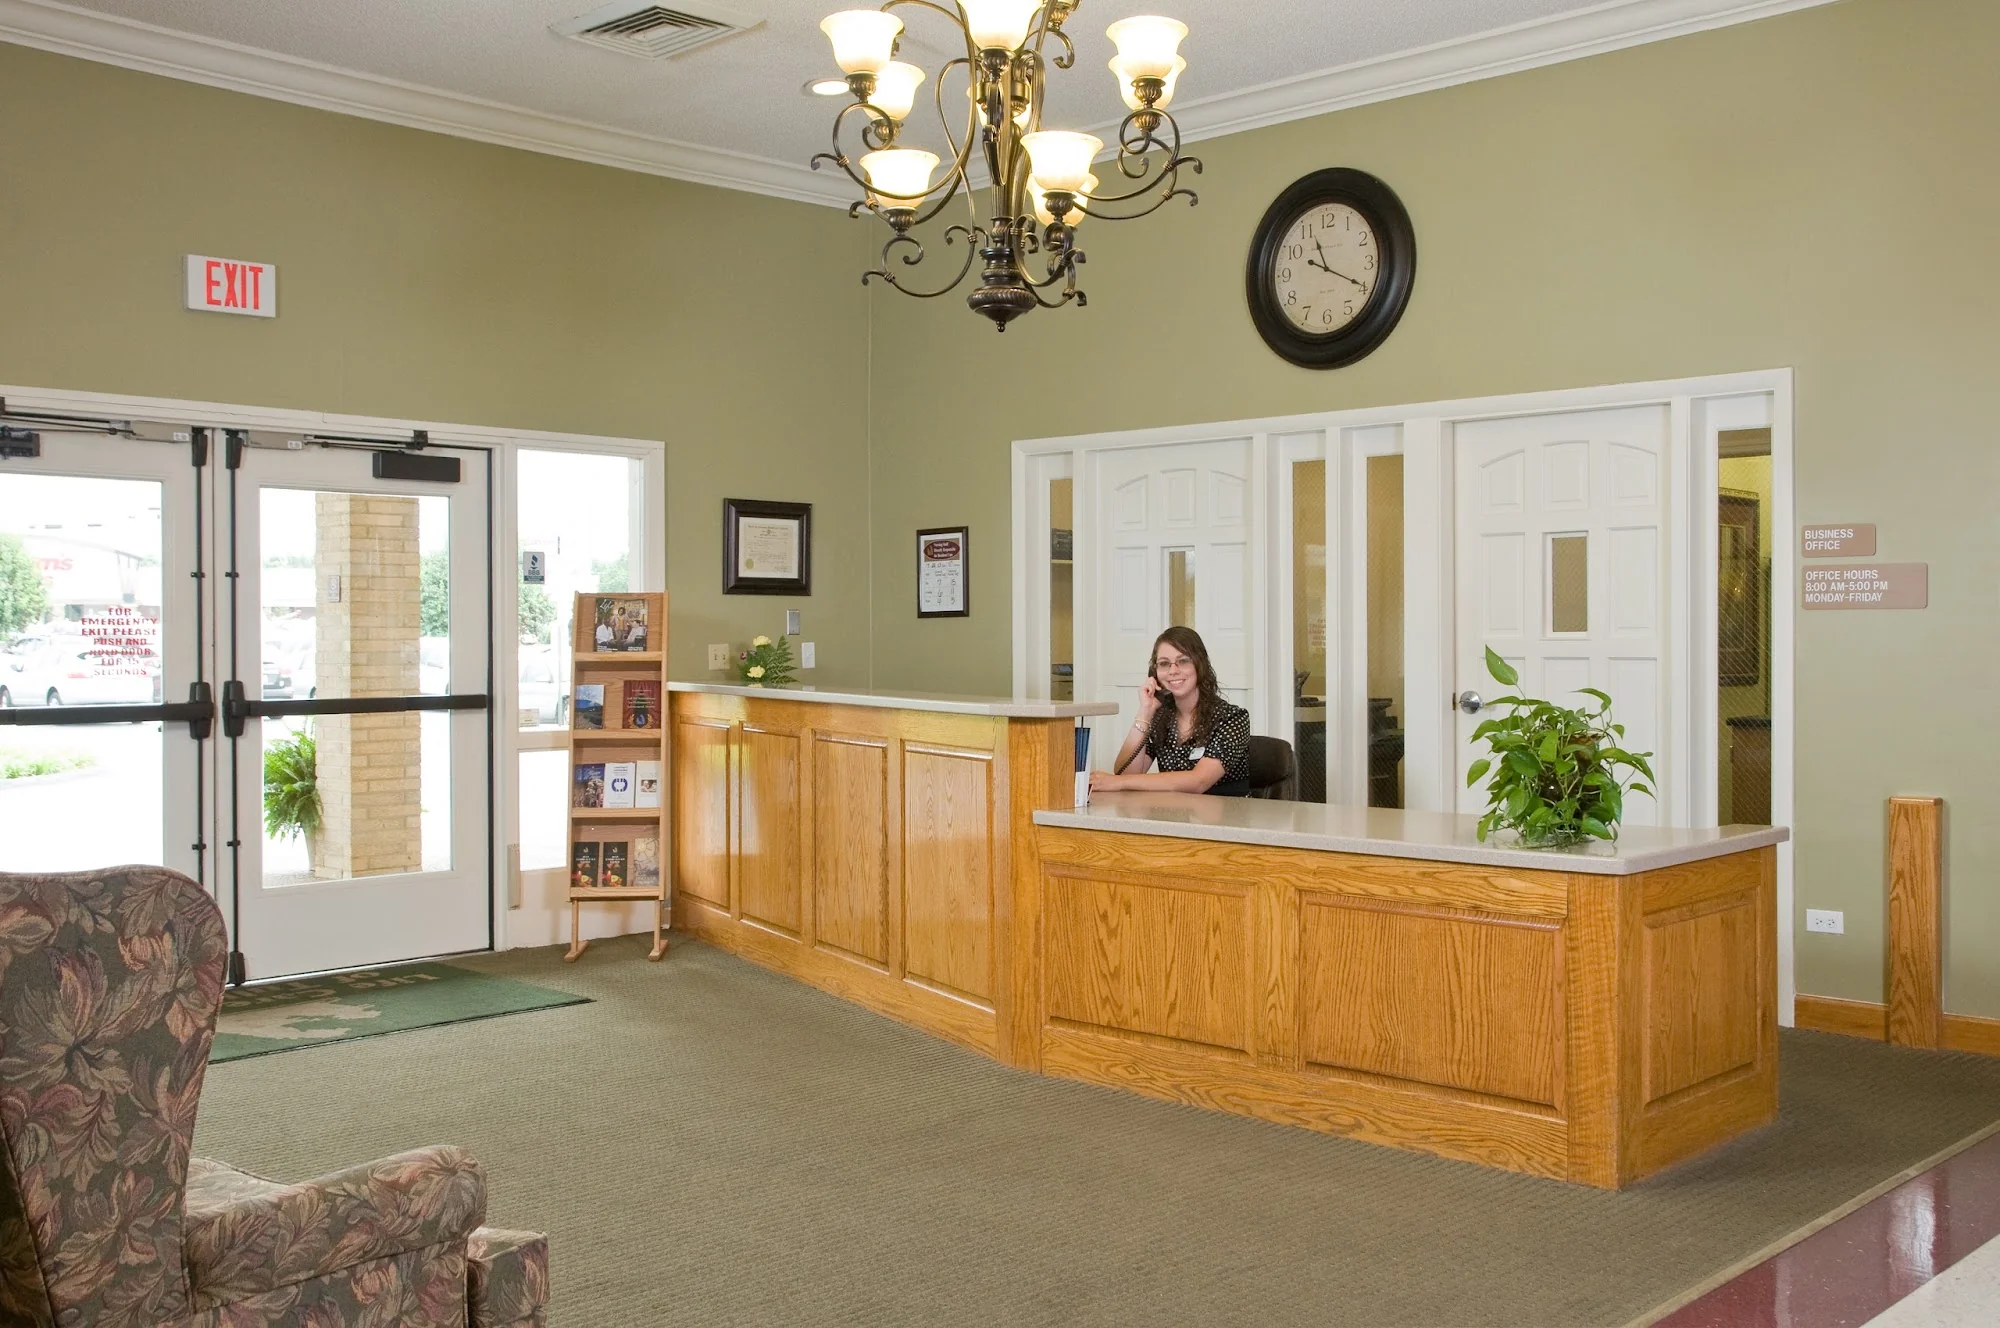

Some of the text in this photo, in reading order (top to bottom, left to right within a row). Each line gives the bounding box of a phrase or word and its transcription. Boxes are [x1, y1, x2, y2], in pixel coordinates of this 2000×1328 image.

[1321, 213, 1335, 229] 12
[1346, 216, 1350, 231] 1
[1301, 224, 1313, 239] 11
[1358, 231, 1368, 247] 2
[1288, 244, 1303, 260] 10
[1364, 254, 1374, 270] 3
[1281, 267, 1292, 282] 9
[206, 260, 263, 310] EXIT
[1358, 281, 1368, 295] 4
[1287, 290, 1297, 305] 8
[1302, 305, 1312, 321] 7
[1343, 300, 1353, 315] 5
[1322, 309, 1332, 324] 6
[1804, 529, 1854, 540] BUSINESS
[1805, 540, 1841, 551] OFFICE
[1805, 570, 1879, 581] OFFICE HOURS
[1805, 580, 1888, 592] 8:00 AM-5:00 PM
[1805, 592, 1883, 603] MONDAY-FRIDAY
[108, 608, 132, 616] FOR
